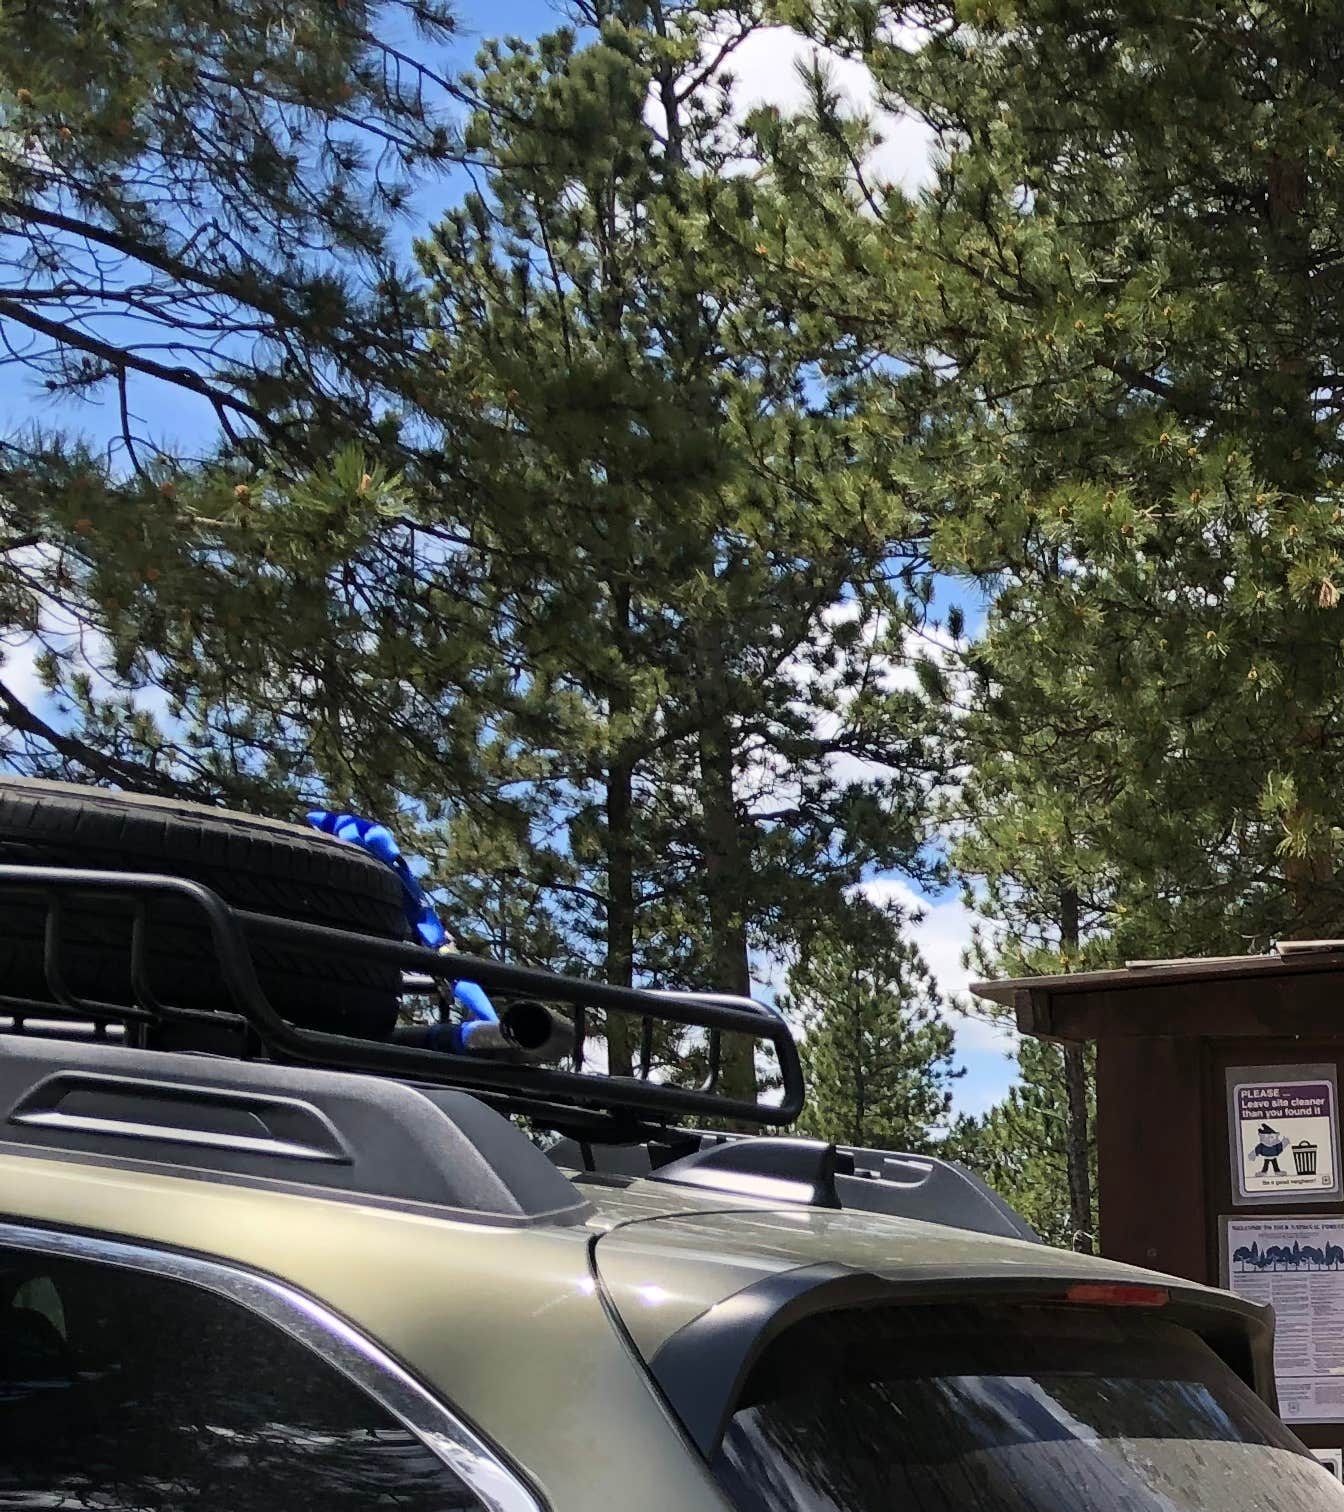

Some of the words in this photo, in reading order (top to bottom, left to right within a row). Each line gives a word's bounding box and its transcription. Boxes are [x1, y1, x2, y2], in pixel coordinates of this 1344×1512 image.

[1241, 1089, 1280, 1098] PLEASE
[1242, 1099, 1269, 1108] Leave
[1291, 1098, 1324, 1107] cleaner
[1242, 1110, 1263, 1118] than
[1265, 1110, 1282, 1119] you
[1285, 1108, 1312, 1117] found
